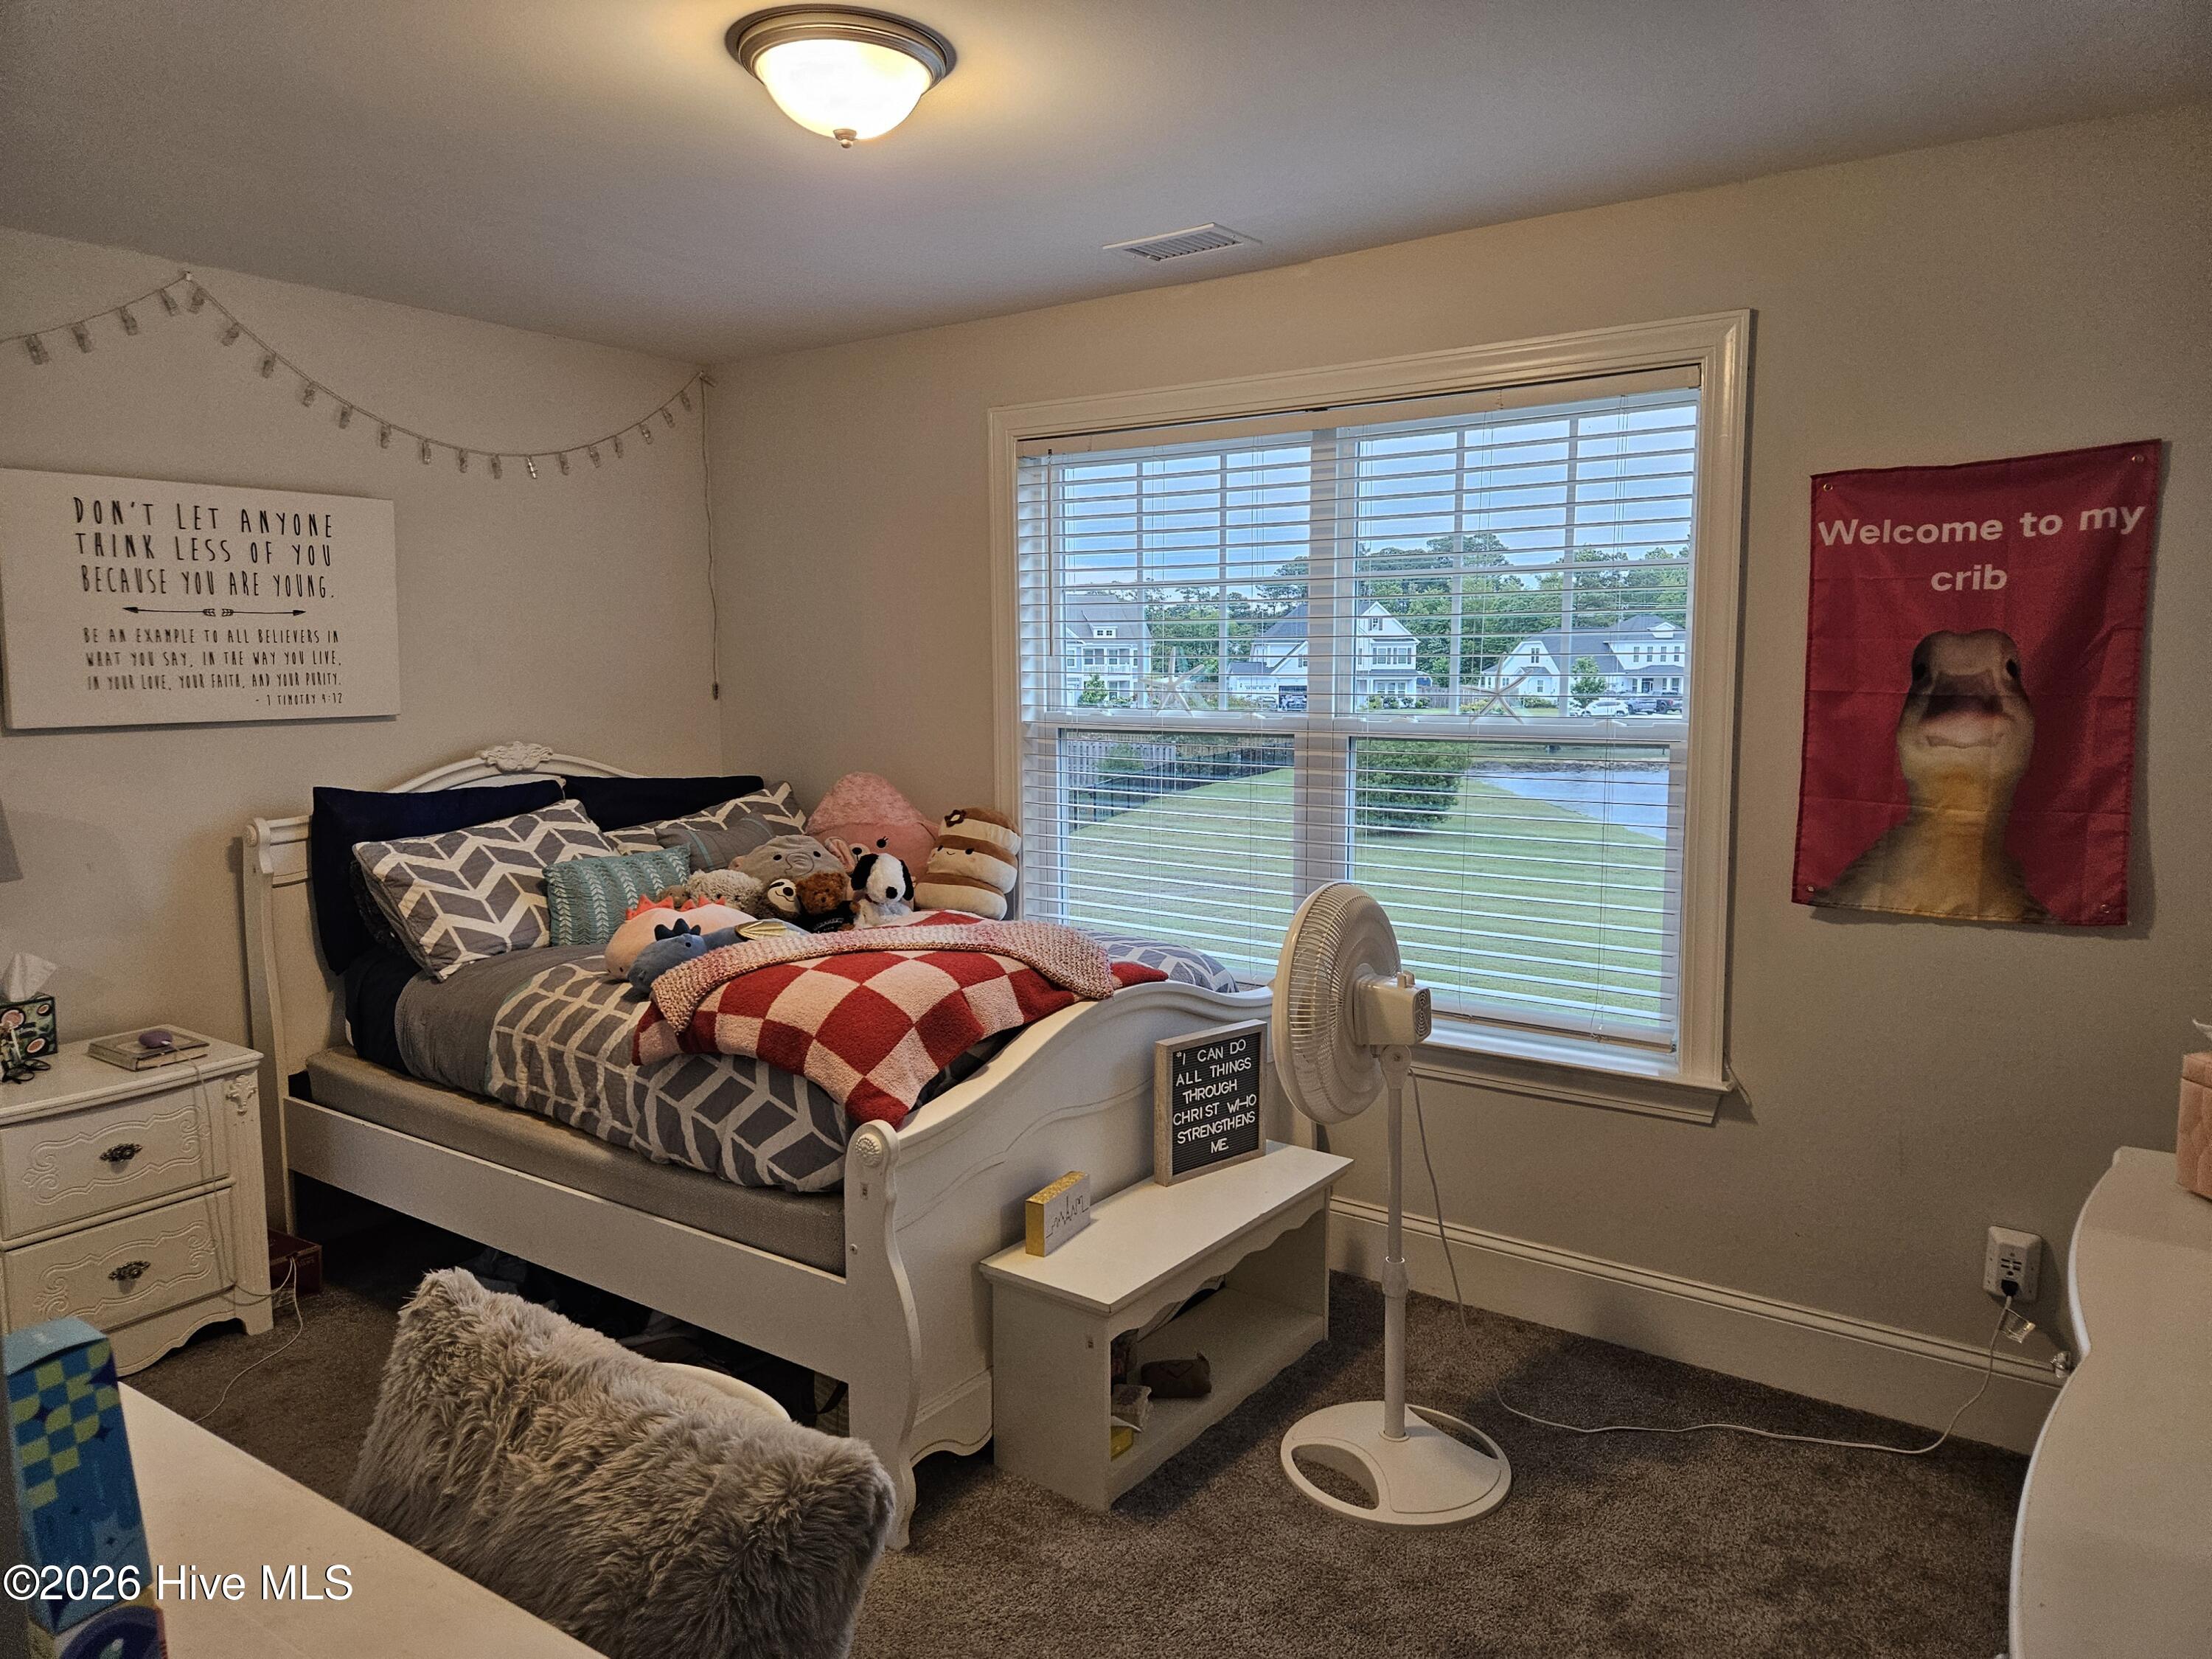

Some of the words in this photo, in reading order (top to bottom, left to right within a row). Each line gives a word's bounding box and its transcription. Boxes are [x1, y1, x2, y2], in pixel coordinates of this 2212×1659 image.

[73, 496, 153, 526] DON'T
[176, 503, 219, 530] LET
[240, 509, 333, 538] ANYONE
[1818, 518, 2004, 546] Welcome
[2018, 512, 2063, 538] to
[2078, 503, 2146, 535] my
[74, 532, 155, 559] THINK
[175, 536, 231, 563] LESS
[250, 541, 272, 564] OF
[291, 543, 331, 567] YOU
[81, 564, 167, 594] BECAUSE
[181, 570, 215, 596] YOU
[229, 570, 260, 597] ARE
[273, 574, 334, 599] YOUNG.
[1930, 564, 2008, 591] crib
[83, 627, 99, 643] BE
[109, 628, 126, 643] AN
[136, 628, 195, 644] EXAMPLE
[204, 629, 218, 644] TO
[227, 629, 250, 644] ALL
[258, 629, 320, 644] BELIEVERS
[327, 630, 338, 644] IN
[86, 651, 122, 667] WHAT
[130, 651, 155, 667] YOU
[203, 651, 215, 666] IN
[223, 650, 244, 665] THE
[252, 651, 276, 665] WAY
[283, 650, 305, 665] YOU
[87, 676, 100, 690] IN
[106, 674, 135, 690] YOUR
[178, 673, 205, 689] YOUR
[251, 673, 271, 687] AND
[276, 672, 300, 687] YOUR
[276, 693, 316, 706] TIMOTHY
[321, 692, 343, 704] 4:12
[1197, 1046, 1224, 1062] CAN
[1229, 1039, 1247, 1055] DO
[1175, 1069, 1203, 1088] ALL
[1209, 1057, 1252, 1078] THINGS
[1182, 1078, 1238, 1105] THROUGH
[1172, 1102, 1220, 1126] CHRIST
[1226, 1093, 1257, 1114] WHO
[1177, 1110, 1256, 1144] STRENGTHENS
